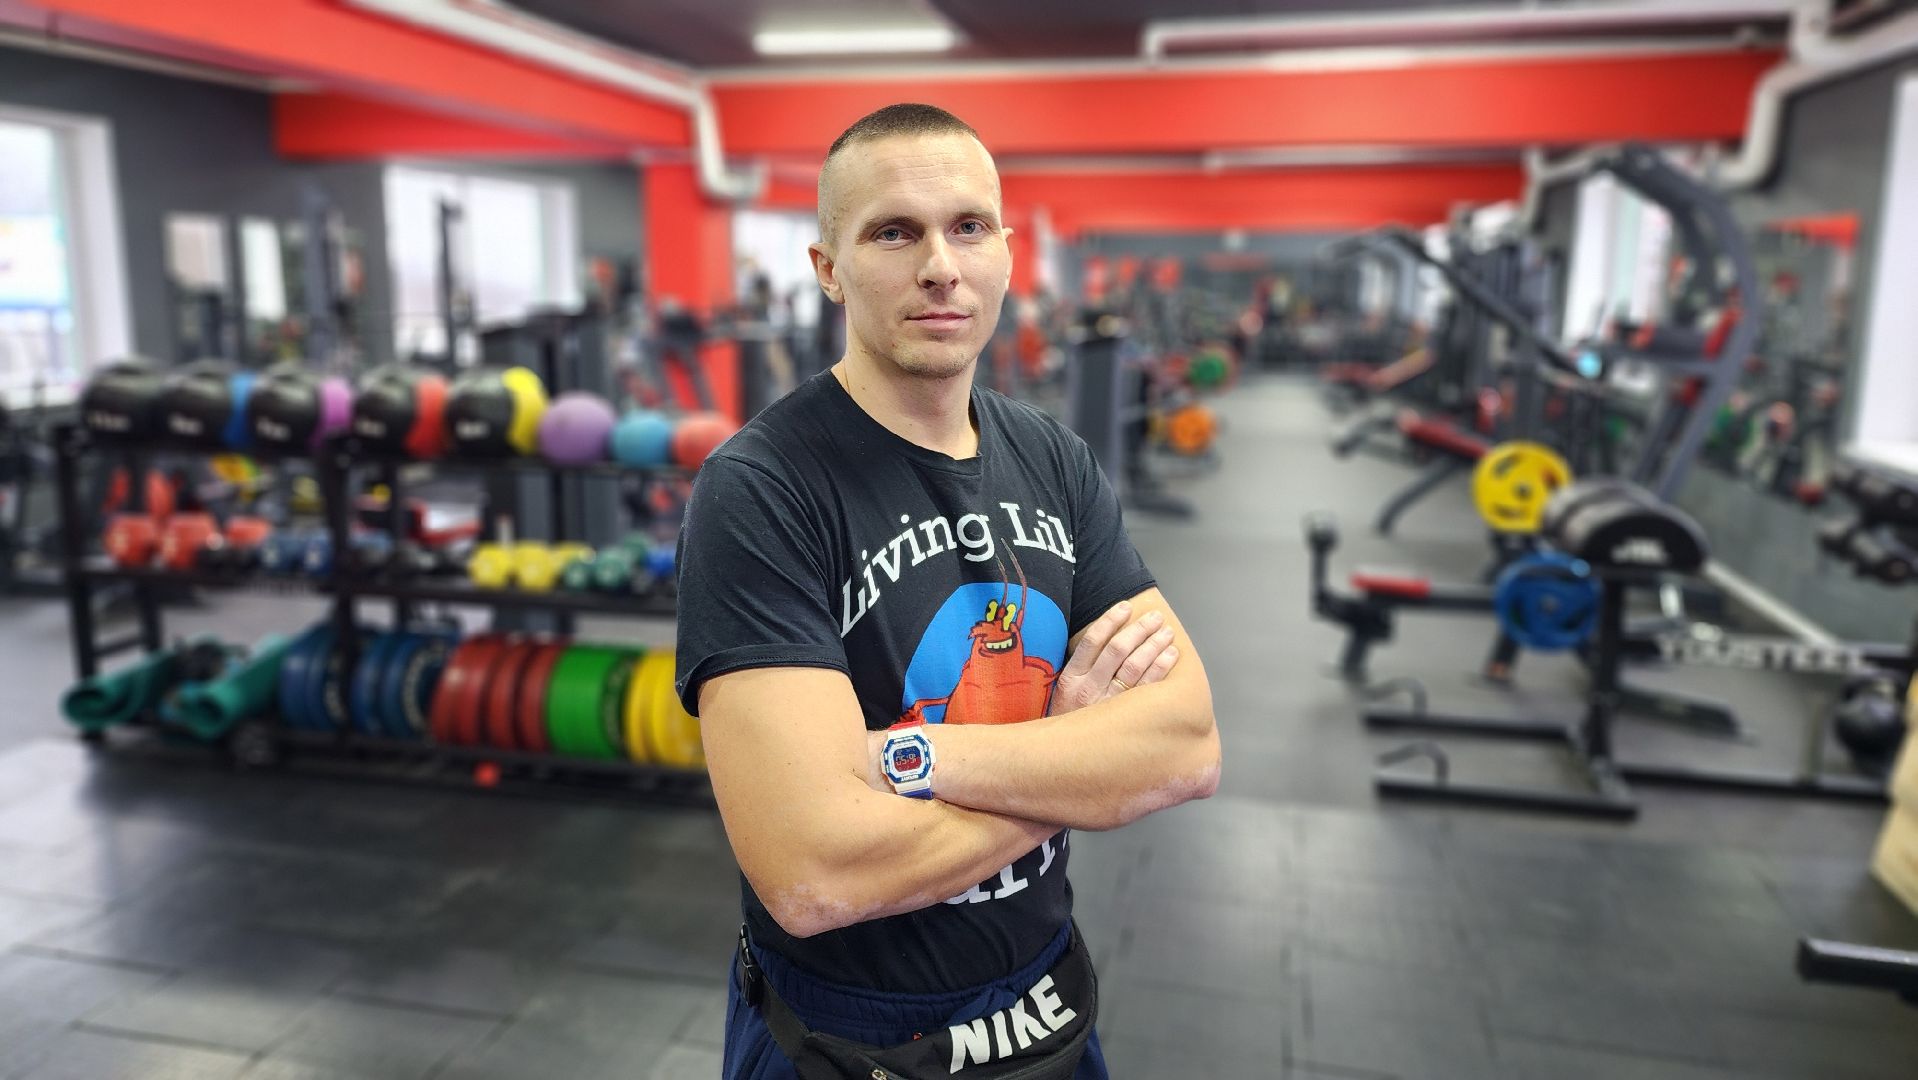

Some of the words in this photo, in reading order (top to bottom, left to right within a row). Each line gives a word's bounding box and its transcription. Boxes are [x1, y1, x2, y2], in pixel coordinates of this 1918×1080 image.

[841, 513, 995, 638] Living
[999, 502, 1076, 575] Lik
[948, 974, 1078, 1074] NIKE
